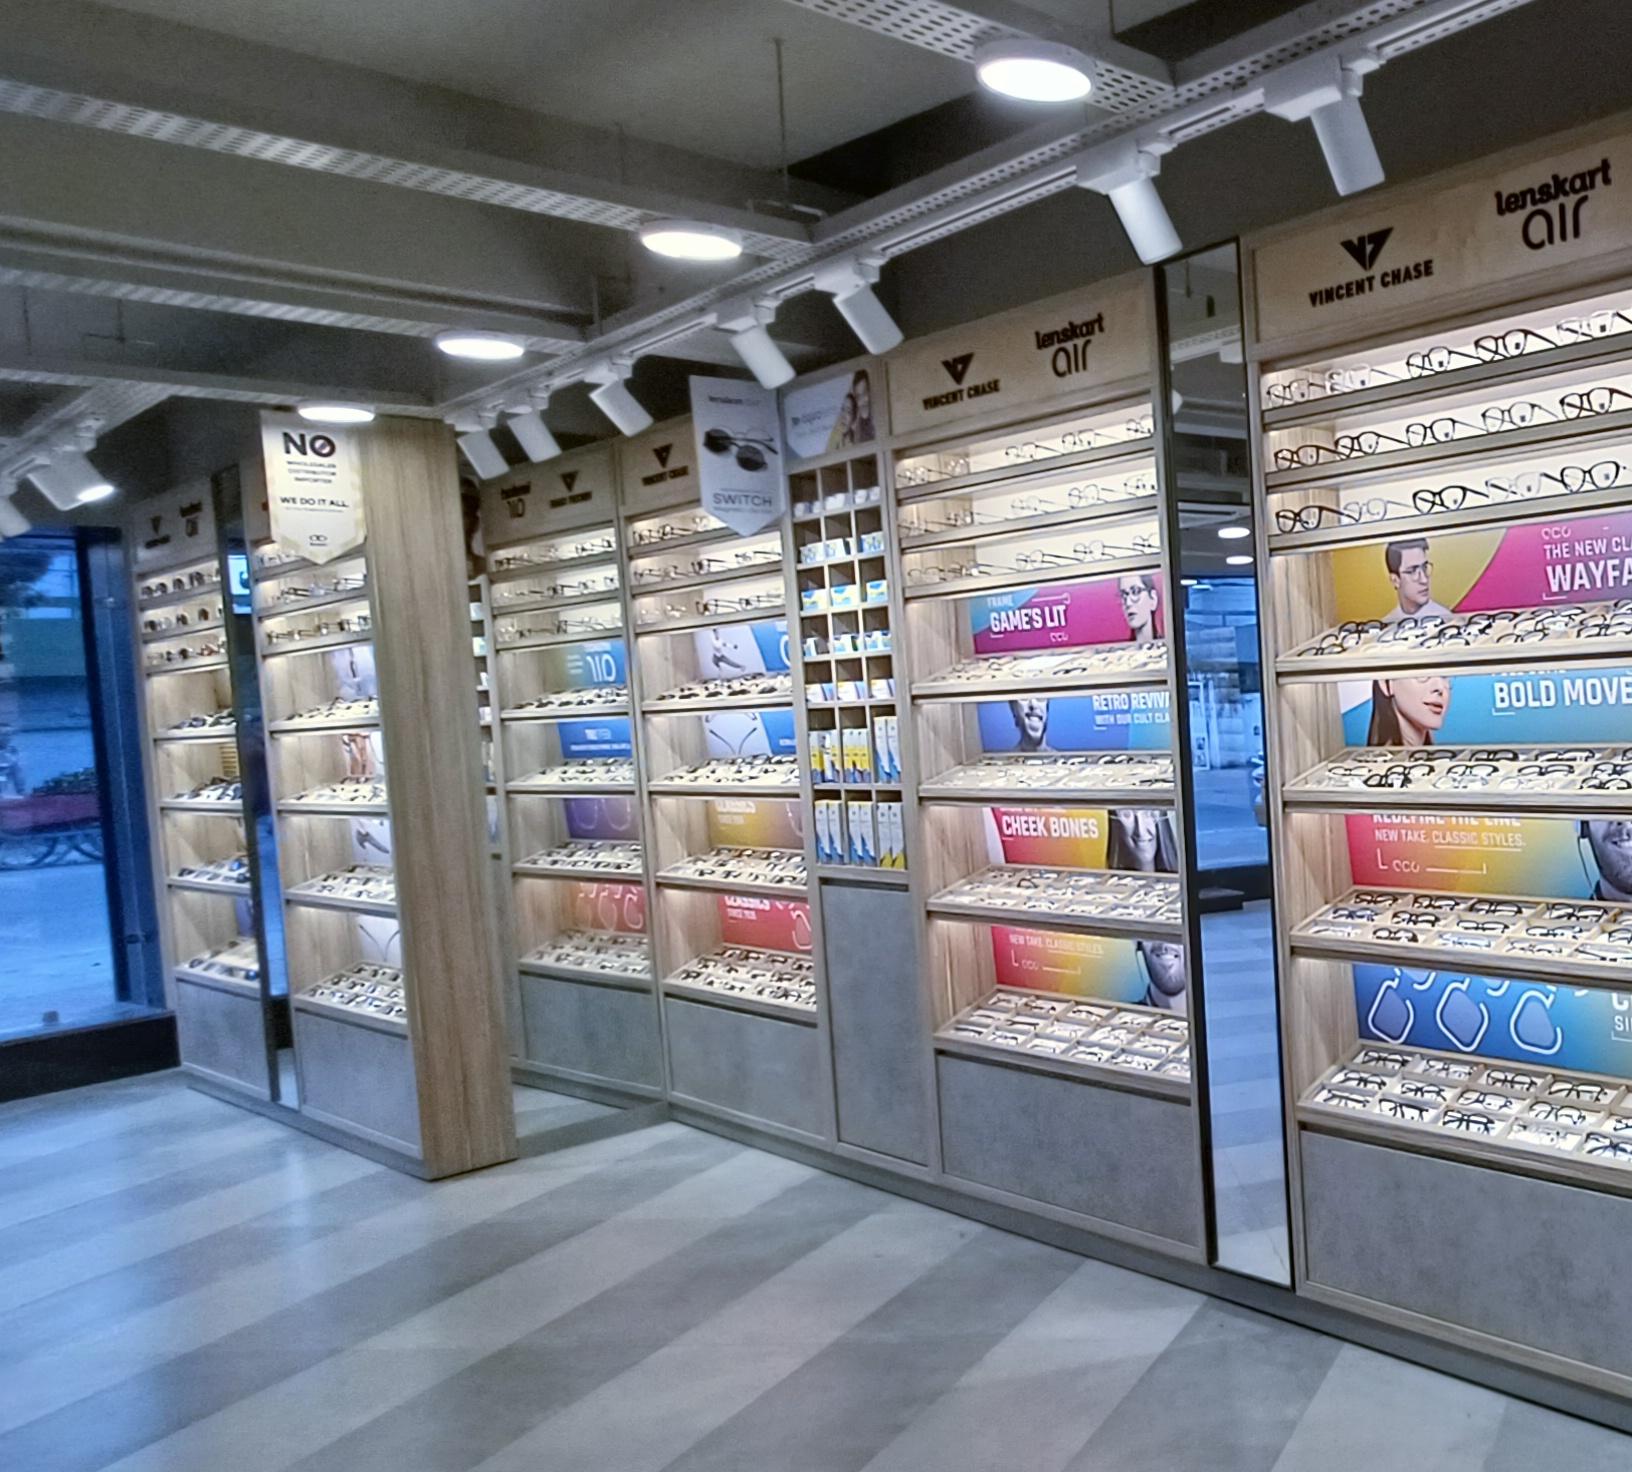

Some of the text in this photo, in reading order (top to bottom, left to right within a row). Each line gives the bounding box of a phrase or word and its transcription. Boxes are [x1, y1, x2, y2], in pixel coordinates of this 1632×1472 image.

[1495, 158, 1611, 216] lenskart
[1522, 195, 1588, 250] air
[1309, 259, 1433, 307] VINCENT CHASE
[1034, 312, 1104, 350] lenskart
[1052, 339, 1091, 377] air
[280, 496, 297, 504] WE
[300, 497, 316, 506] DO
[713, 493, 772, 507] SWITCH
[1544, 543, 1570, 560] THE
[1574, 538, 1607, 557] NEW
[989, 605, 1066, 633] GAME'S LIT
[1092, 693, 1129, 711] RETRO
[1494, 679, 1556, 708] BOLD
[1001, 815, 1099, 839] CHEEK BONES
[1374, 829, 1399, 842] NEW
[1432, 830, 1478, 844] CLASSIC
